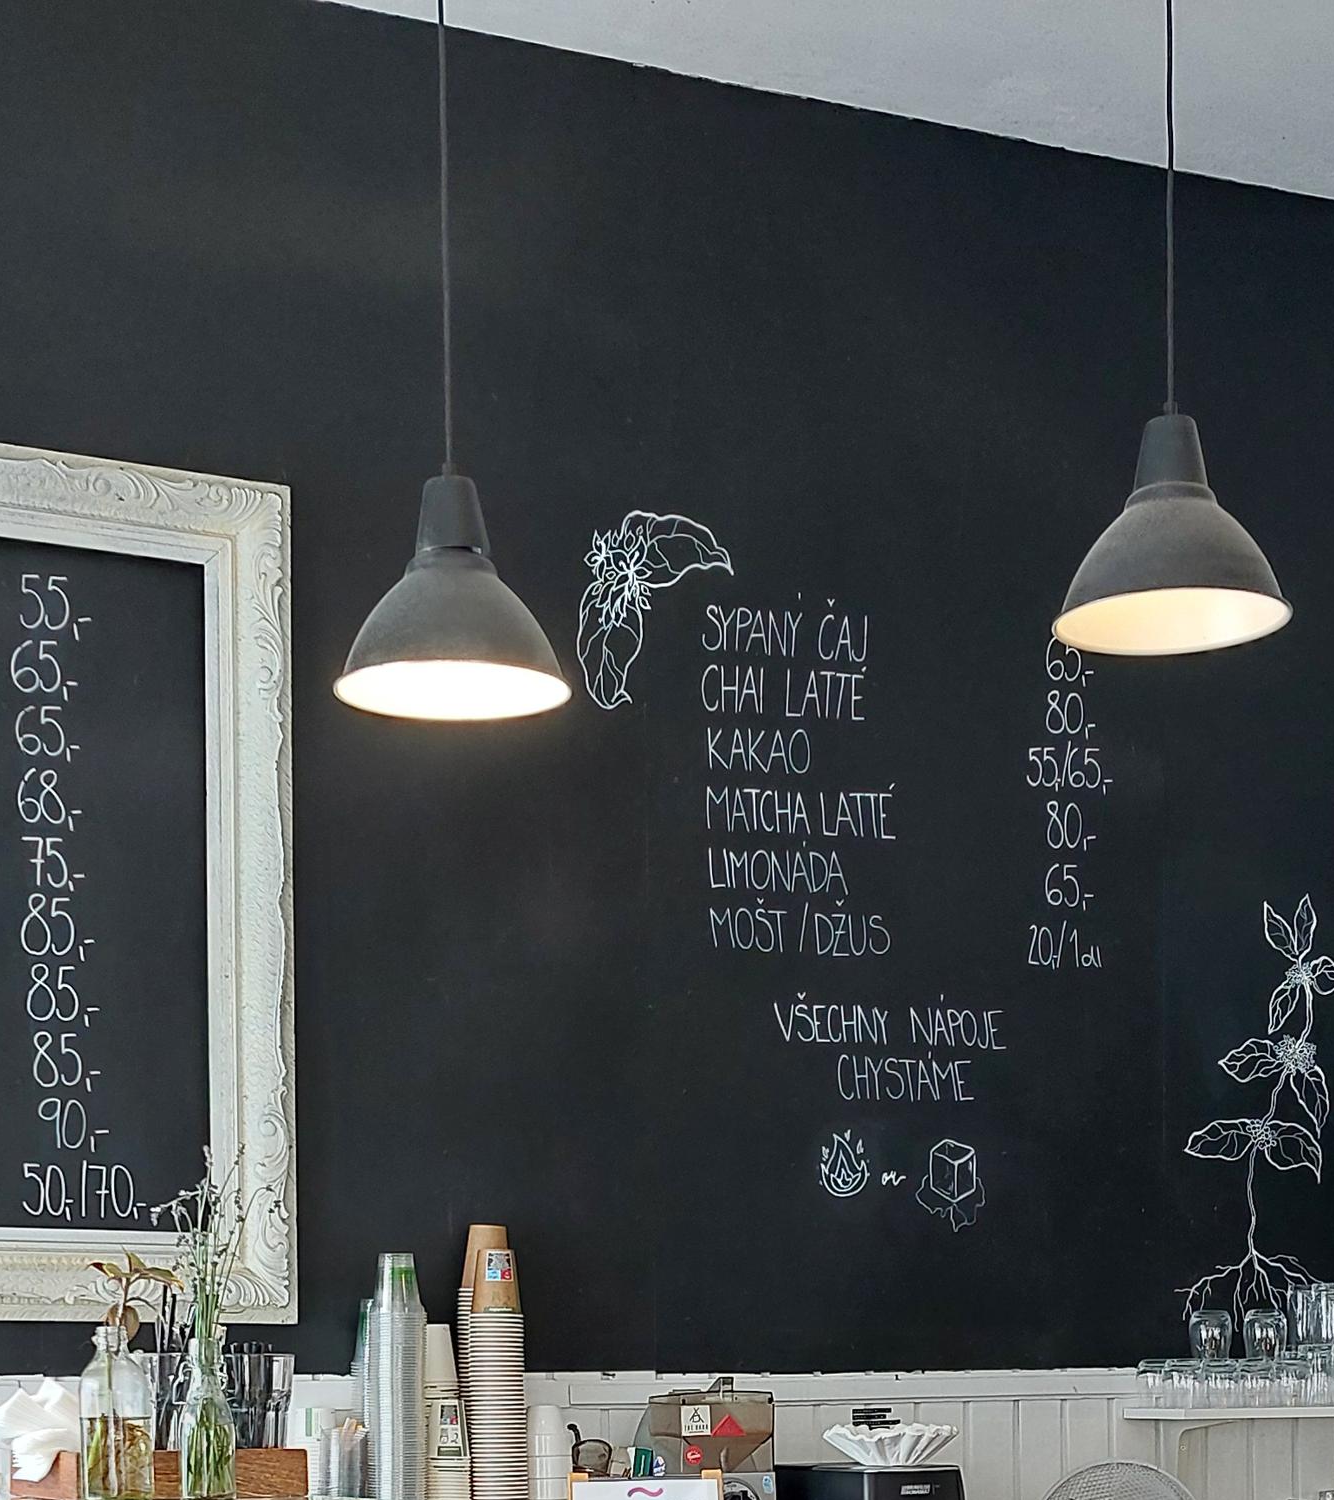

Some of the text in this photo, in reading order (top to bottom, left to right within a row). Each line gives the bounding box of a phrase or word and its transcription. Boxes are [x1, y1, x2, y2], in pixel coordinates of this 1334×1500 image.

[701, 592, 801, 657] SYPANÝ
[818, 599, 868, 663] ČAJ
[701, 664, 765, 714] CHAI
[708, 728, 810, 775] KAKAO
[706, 786, 809, 834] MATCHA
[708, 842, 848, 895] LIMONÁDA
[774, 993, 1007, 1051] VŠECHNY NÁPOJE
[838, 1051, 975, 1101] CHYSTÁME
